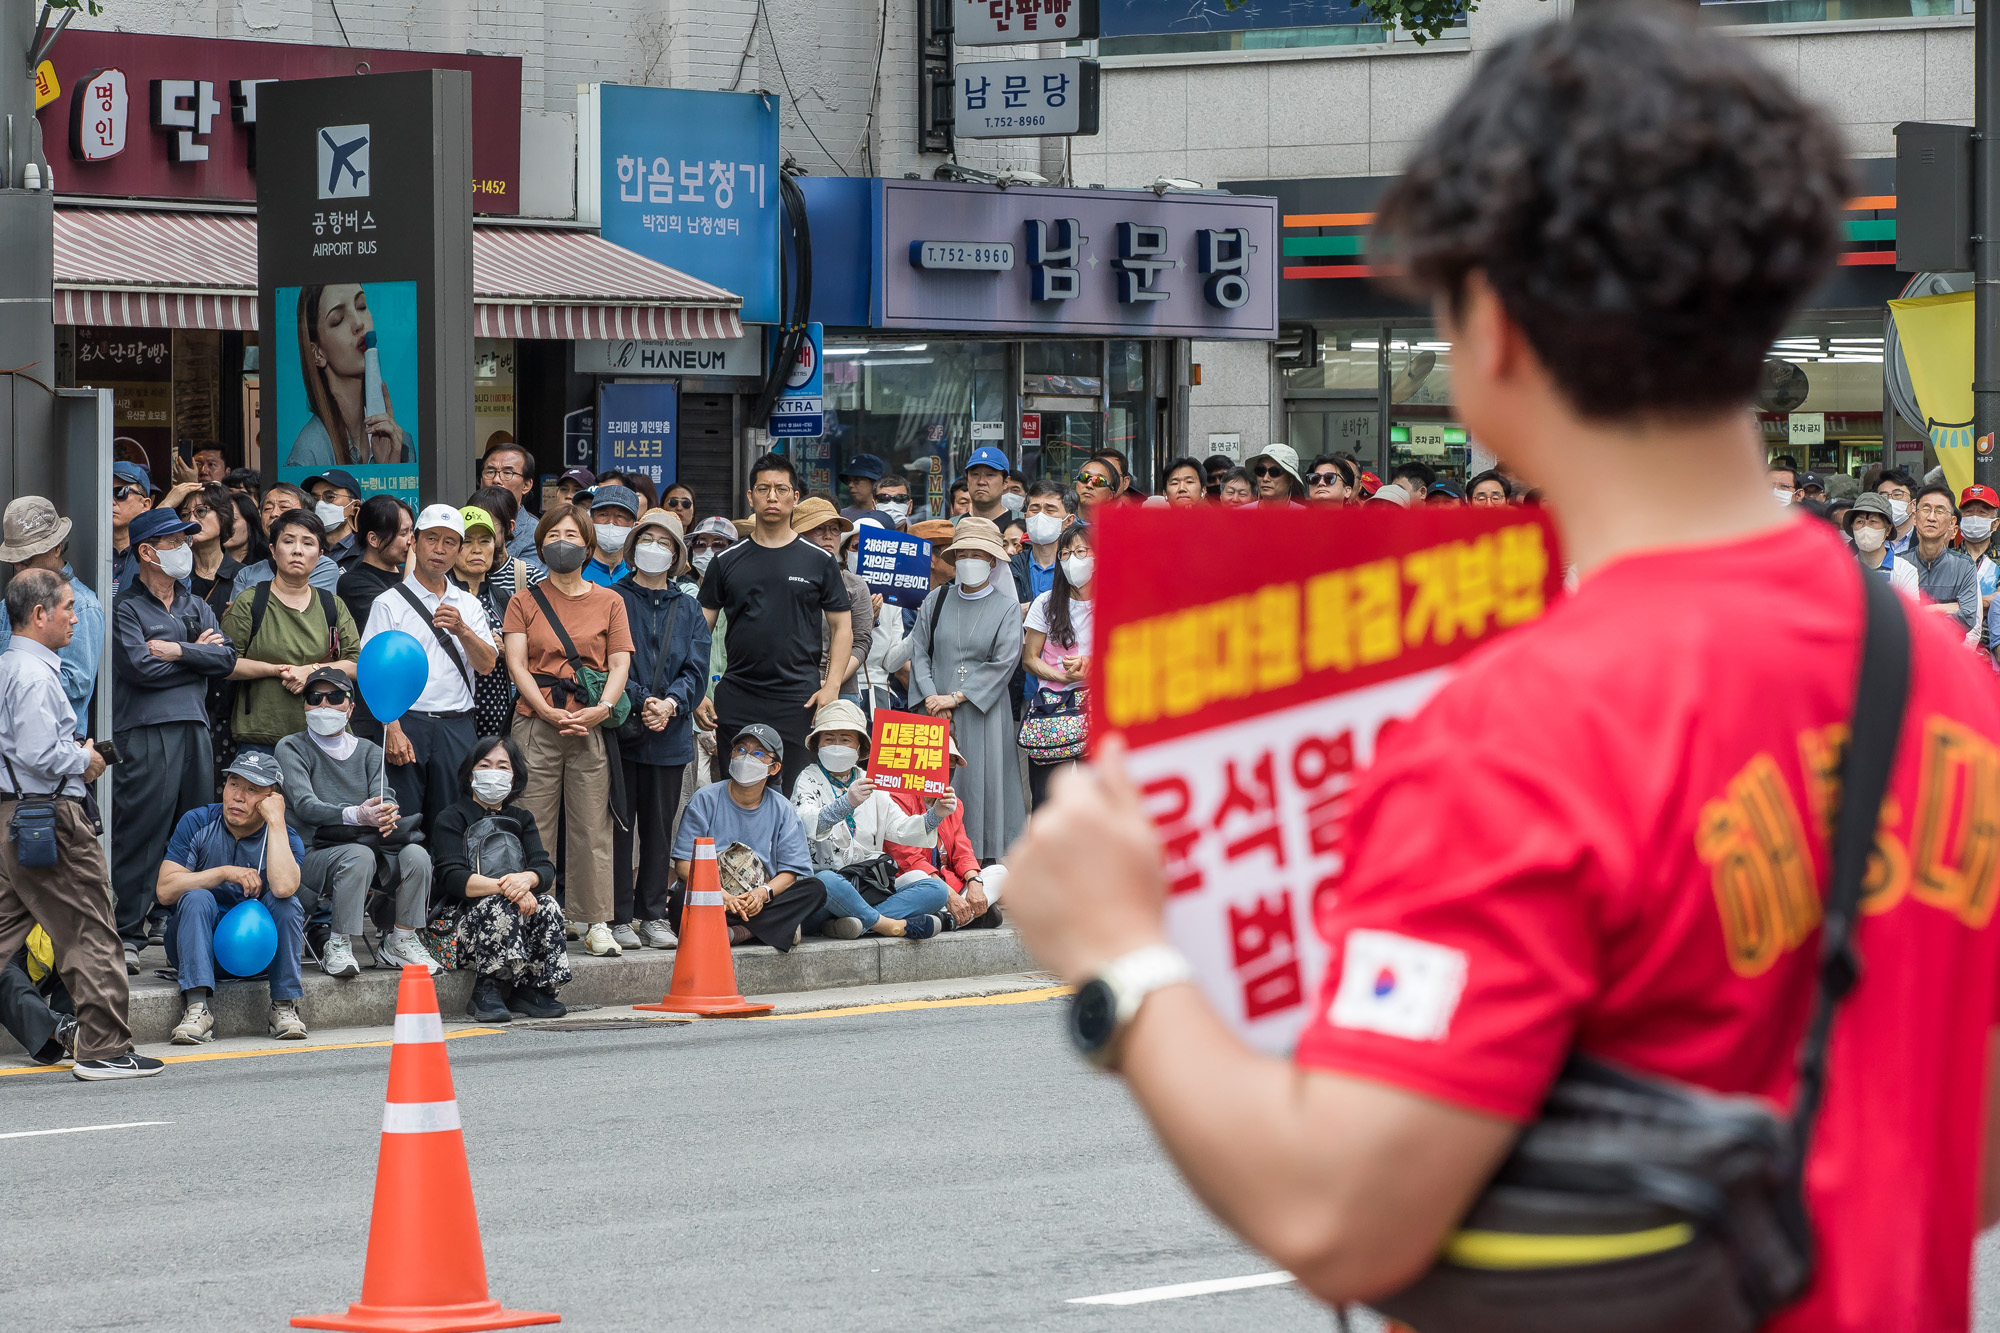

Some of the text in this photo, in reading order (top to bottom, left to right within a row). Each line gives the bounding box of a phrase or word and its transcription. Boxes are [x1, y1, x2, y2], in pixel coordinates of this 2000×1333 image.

[989, 0, 1072, 32] 단팥빵
[965, 73, 1071, 111] 남문당
[95, 83, 114, 146] 명인
[985, 115, 1045, 128] T.752-8960
[616, 154, 765, 209] 한음보청기
[312, 210, 377, 236] 공항버스
[687, 216, 739, 236] 난청센터
[313, 240, 377, 257] AIRPORT BUS
[927, 247, 1009, 264] T.752-8960
[1025, 217, 1258, 309] 남문당
[109, 341, 168, 365] 단팥빵
[641, 350, 726, 370] HANEUM
[777, 401, 814, 413] KTRA
[607, 421, 671, 434] 프리미엄 개인맞춤
[1792, 424, 1806, 433] 주차
[1807, 424, 1821, 432] 금지
[613, 440, 663, 458] 비스포크
[1210, 441, 1239, 452] 흡연금지
[1415, 435, 1441, 444] 주차 금지
[388, 476, 397, 489] 대
[864, 538, 918, 557] 채해병 특검
[862, 554, 896, 570] 재의결
[861, 570, 929, 591] 국민의 명령이다
[1304, 556, 1402, 673] 특검
[1402, 522, 1548, 647] 거부한
[880, 722, 945, 747] 대통령의
[877, 746, 943, 771] 특검 거부
[874, 773, 945, 794] 국민이 거부한다!
